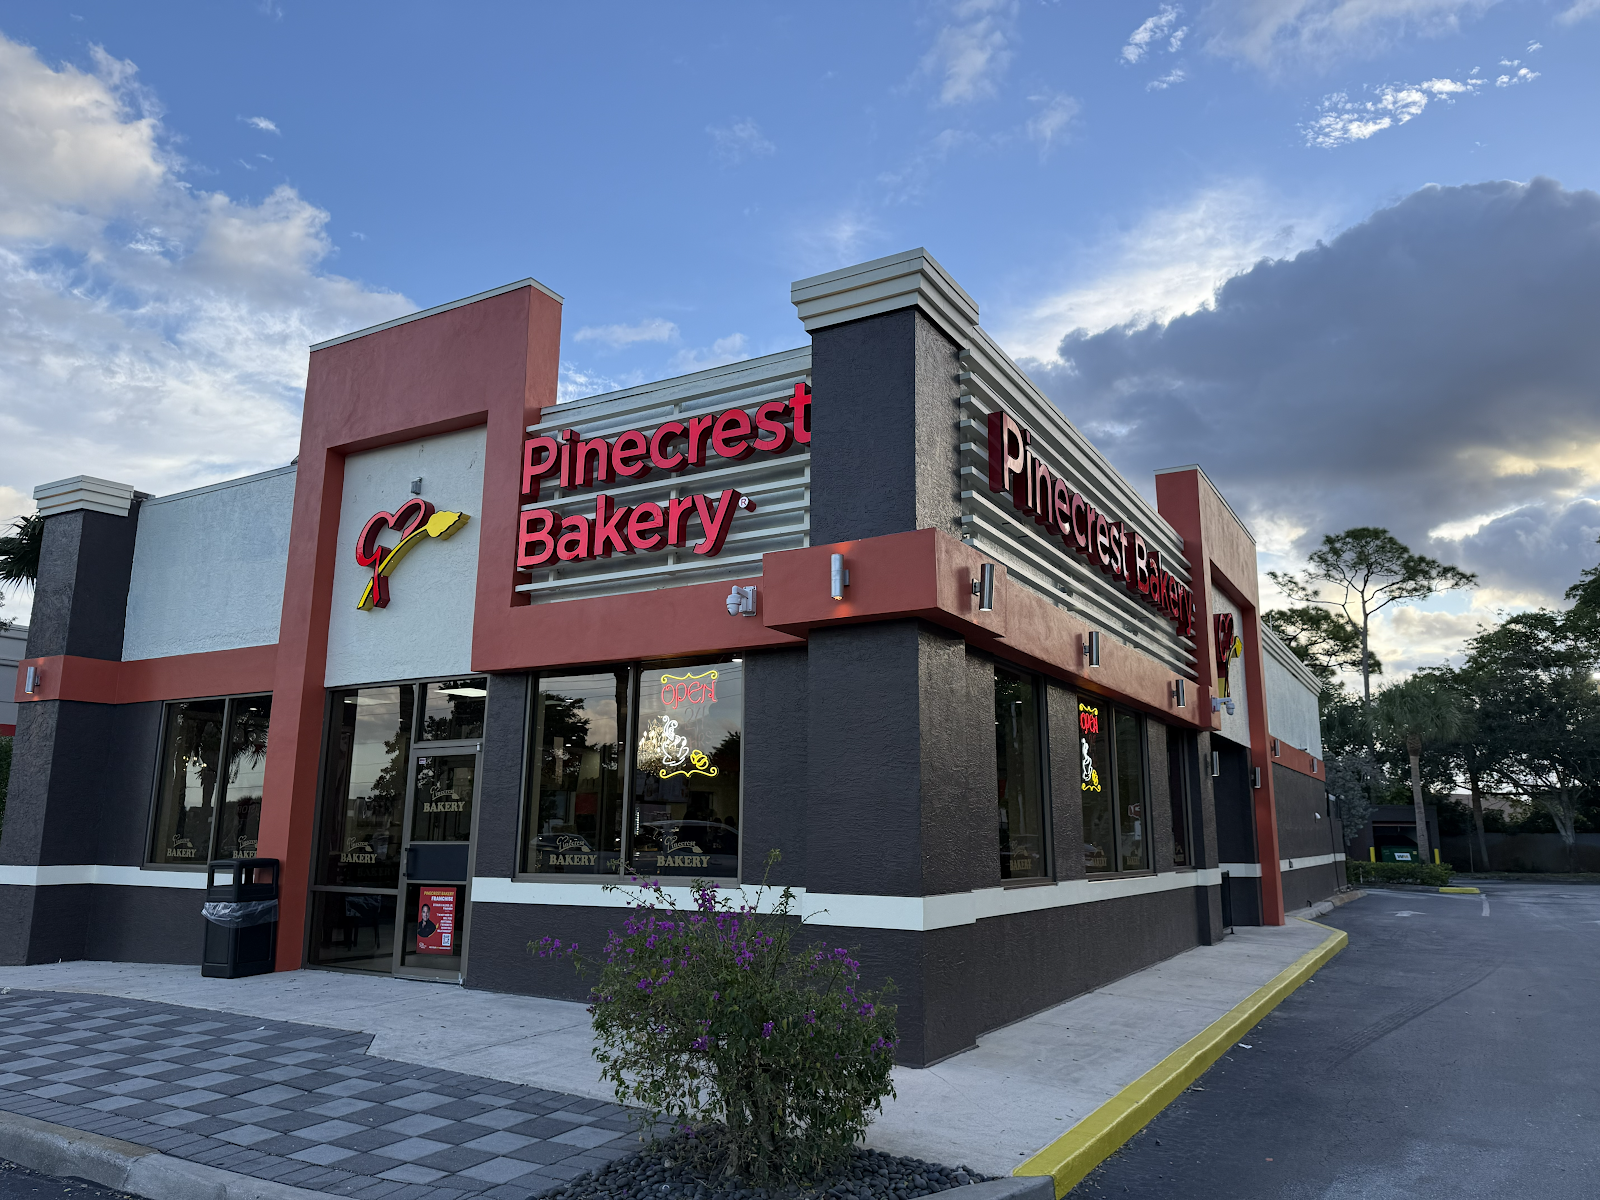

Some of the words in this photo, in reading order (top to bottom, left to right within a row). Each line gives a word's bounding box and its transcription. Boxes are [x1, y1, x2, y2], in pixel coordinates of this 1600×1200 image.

[522, 382, 811, 496] Pinecrest
[988, 411, 1128, 583] Pinecrest
[661, 680, 718, 710] OPEN
[1080, 712, 1099, 734] OPEN
[422, 801, 466, 813] BAKERY
[166, 848, 197, 858] BAKERY
[339, 853, 378, 864] BAKERY
[549, 854, 598, 866] BAKERY
[656, 855, 711, 868] BAKERY
